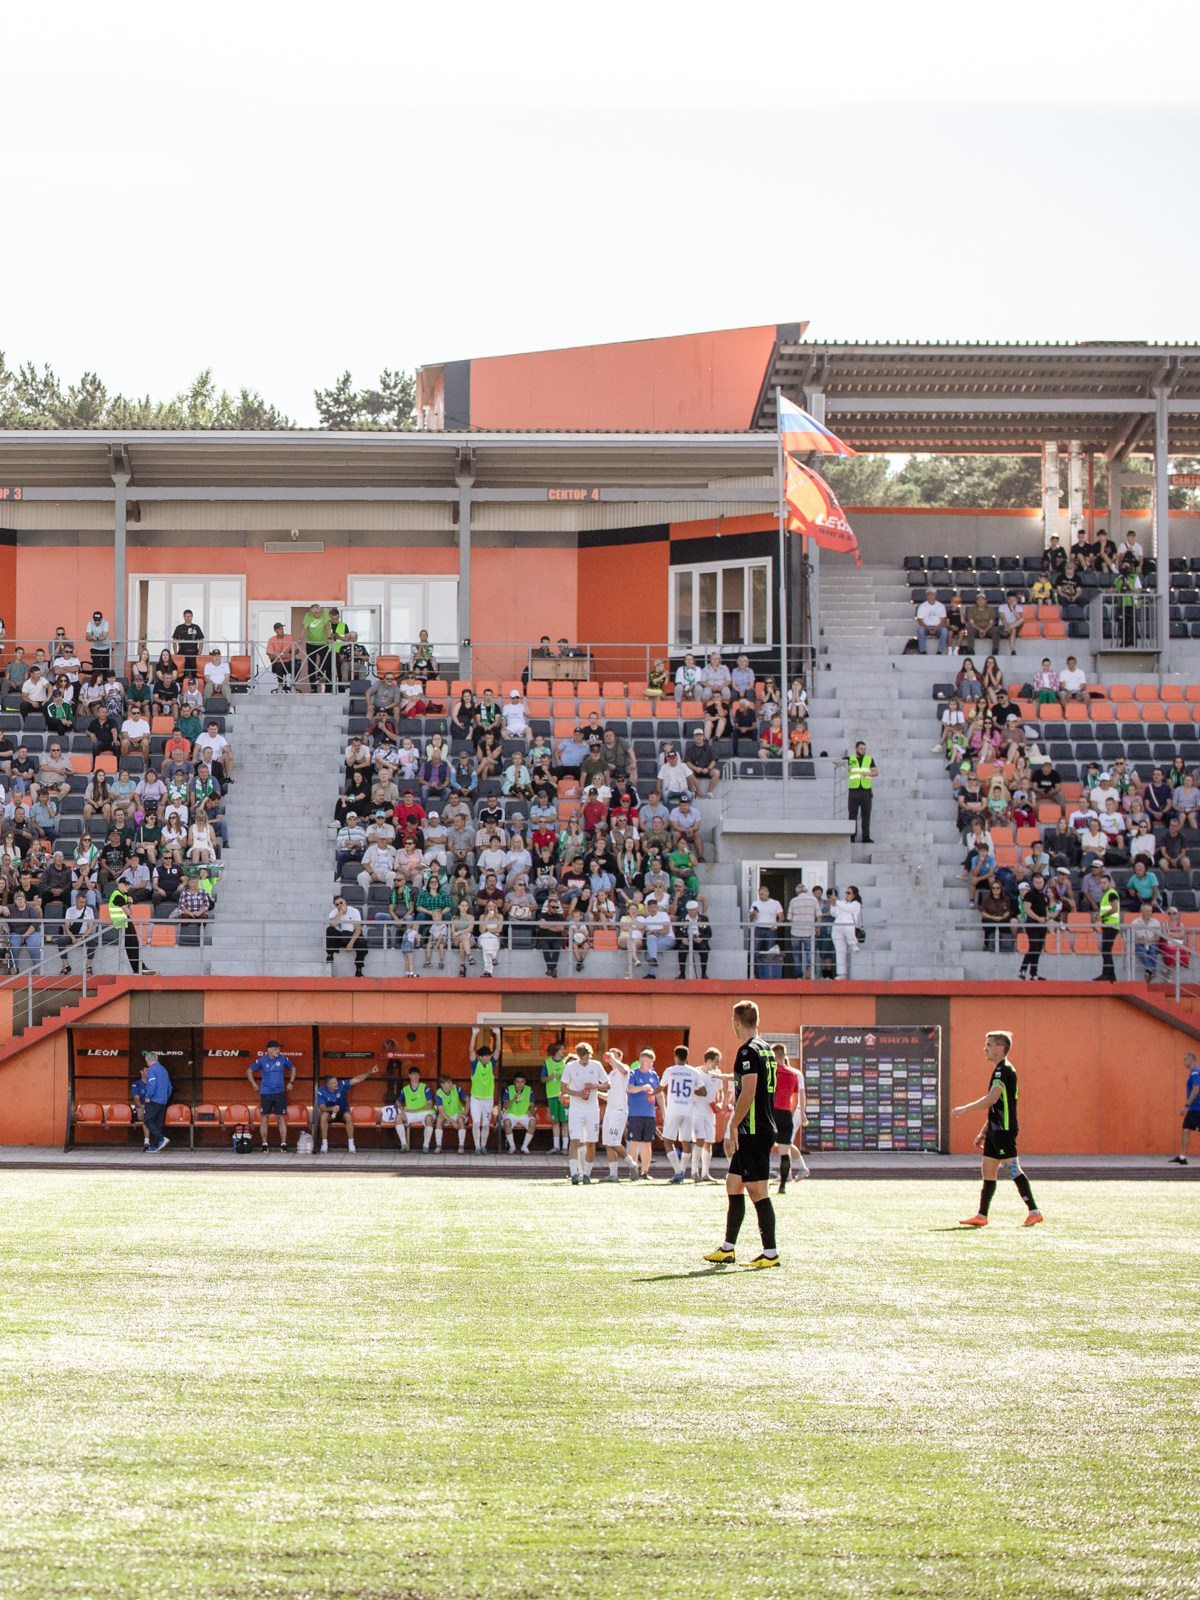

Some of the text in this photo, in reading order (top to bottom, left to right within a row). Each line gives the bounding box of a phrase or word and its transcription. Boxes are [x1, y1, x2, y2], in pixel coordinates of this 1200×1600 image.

[14, 488, 22, 500] 3
[548, 488, 599, 500] СЕКТОР 4
[671, 1079, 692, 1098] 45
[609, 1128, 618, 1136] 44
